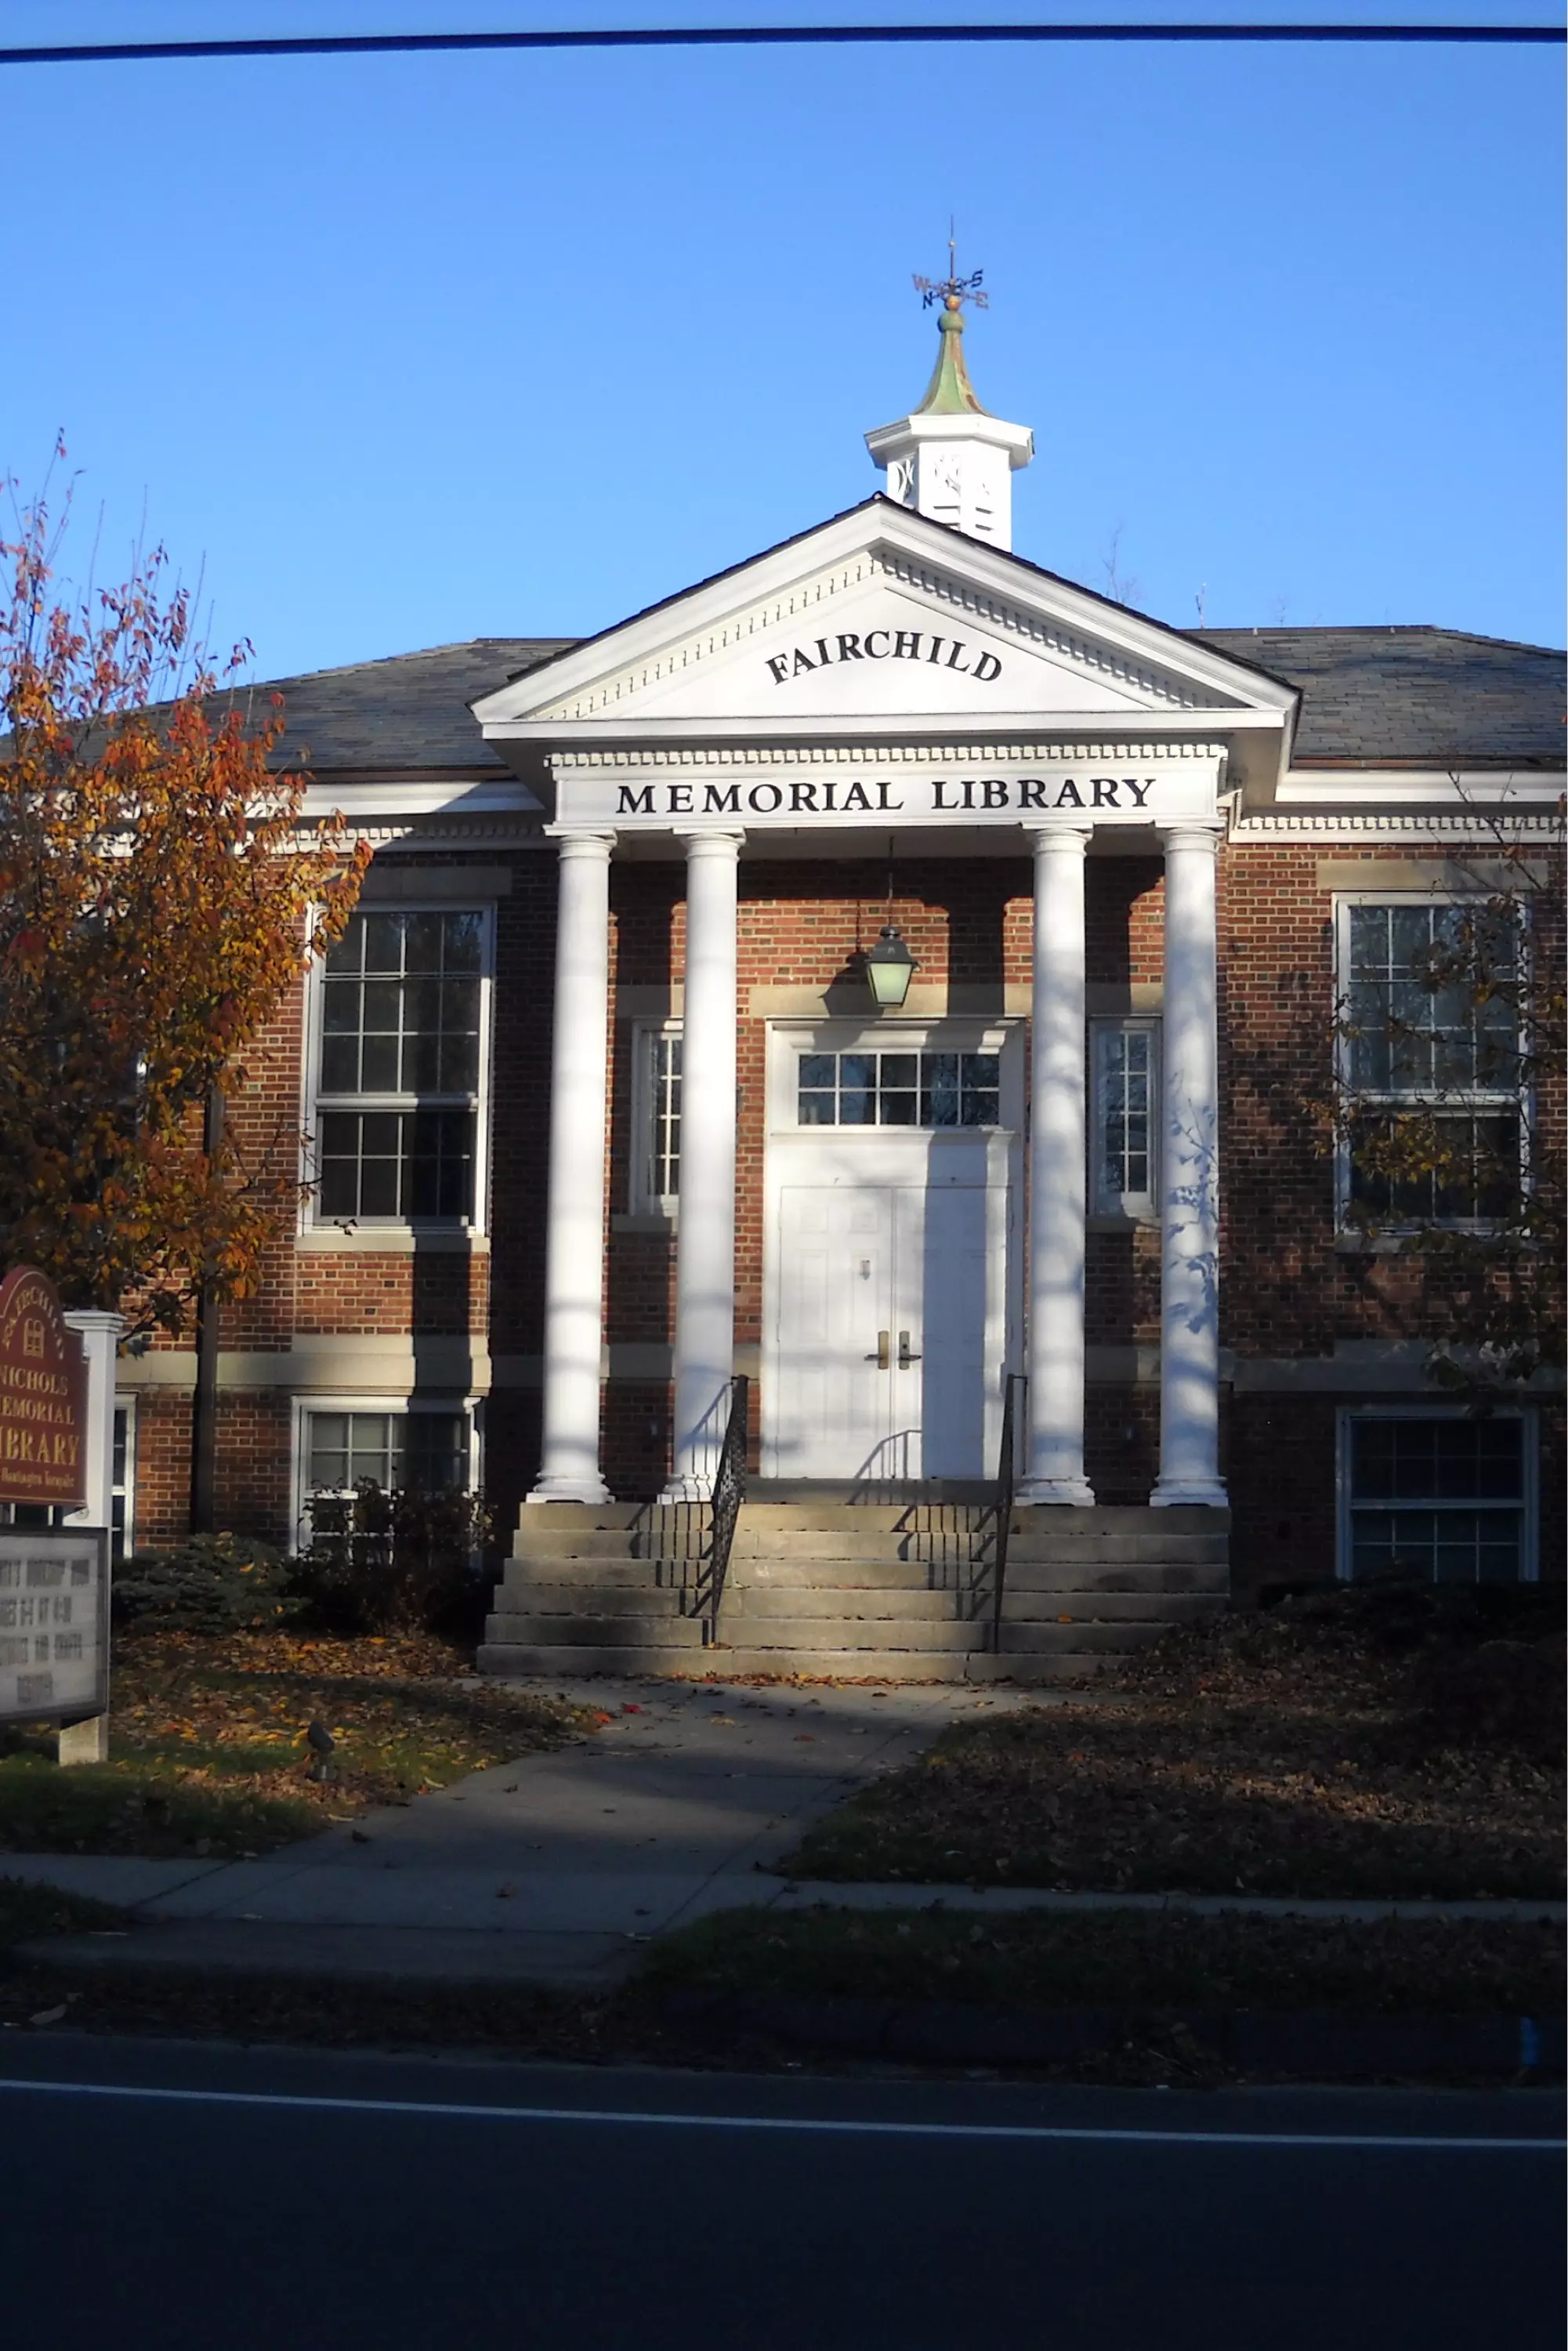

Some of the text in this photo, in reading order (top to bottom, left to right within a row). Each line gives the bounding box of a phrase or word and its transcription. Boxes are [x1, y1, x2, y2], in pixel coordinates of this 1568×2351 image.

[971, 269, 984, 288] S
[922, 291, 932, 310] N
[975, 291, 989, 310] E
[765, 630, 1003, 685] FAIRCHILD
[616, 778, 1157, 813] MEMORIAL LIBRARY
[0, 1364, 69, 1396] NICHOLS
[0, 1395, 74, 1425] EMORIAL
[0, 1425, 79, 1465] IBRARY
